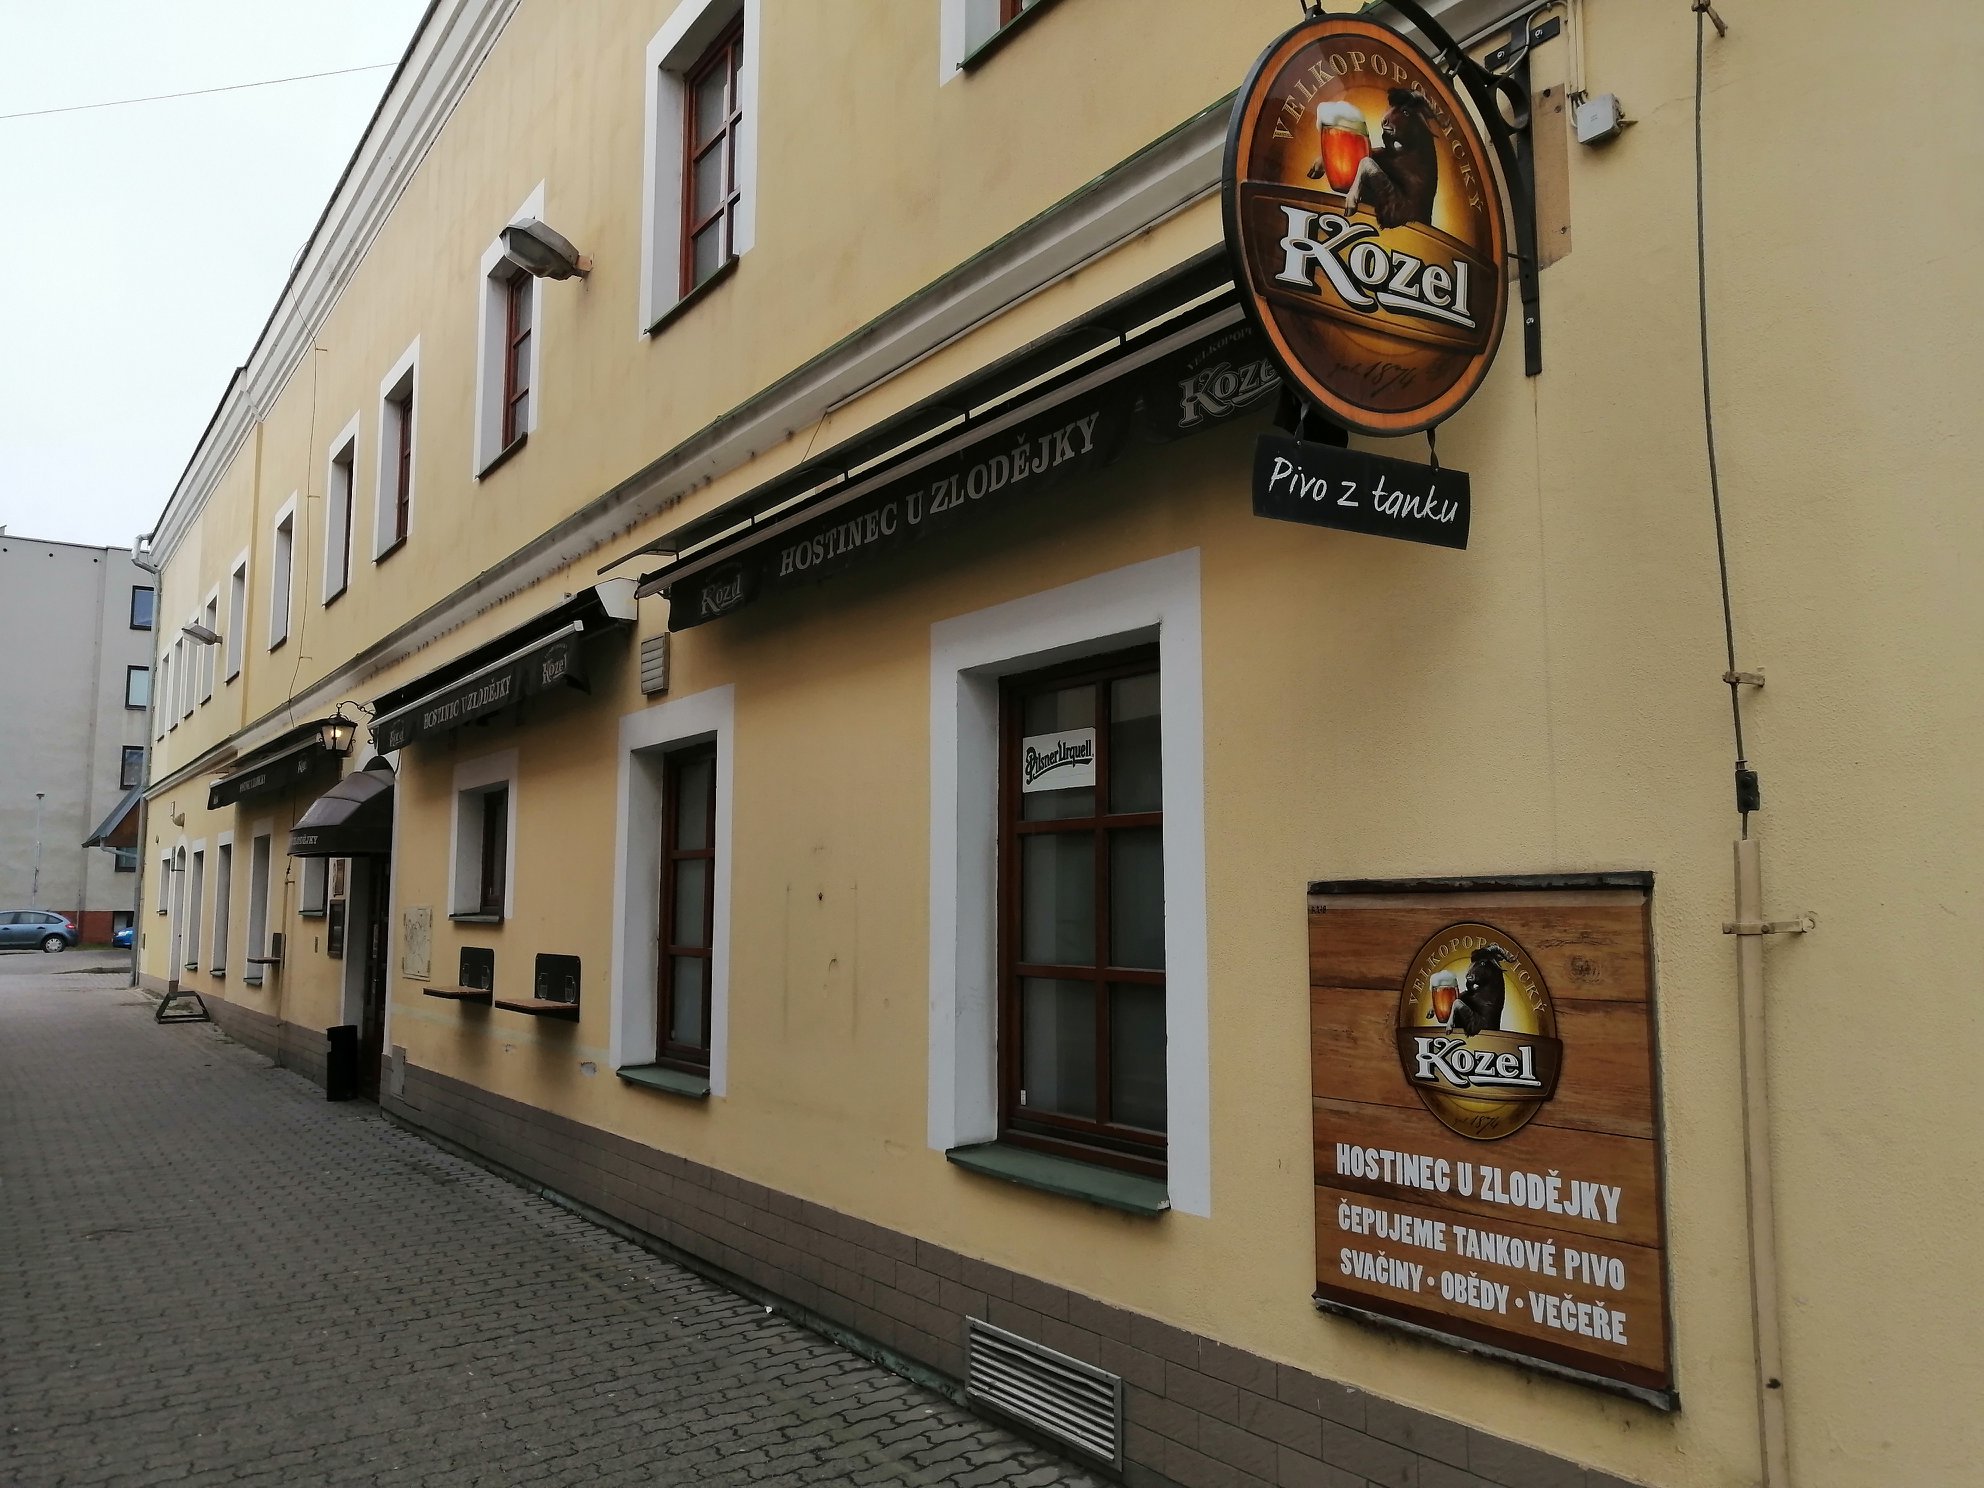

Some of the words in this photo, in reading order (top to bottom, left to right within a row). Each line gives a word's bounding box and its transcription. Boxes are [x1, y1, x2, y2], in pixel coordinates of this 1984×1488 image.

[1275, 204, 1475, 328] Kozel
[1178, 357, 1281, 427] Koze
[1364, 361, 1417, 397] 1874
[779, 502, 898, 577] HOSTINEC
[905, 491, 925, 526] U
[929, 412, 1100, 514] ZLODĚJKY
[1269, 457, 1328, 502] Pivo
[1337, 481, 1359, 507] z
[1372, 475, 1458, 523] tanku
[699, 573, 744, 616] Kozel
[1025, 746, 1059, 785] Pilsner
[1058, 740, 1092, 768] Urquell
[1414, 1036, 1541, 1087] Kozel
[1336, 1143, 1451, 1191] HOSTINEC
[1457, 1161, 1473, 1197] U
[1480, 1165, 1622, 1224] ZLODĚJKY
[1338, 1198, 1447, 1251] ČEPUJEME
[1453, 1225, 1557, 1277] TANKOVÉ
[1564, 1248, 1626, 1291] PIVO
[1340, 1248, 1424, 1293] SVAČINY
[1441, 1271, 1510, 1315] OBĚDY
[1529, 1290, 1628, 1346] VEČEŘE
